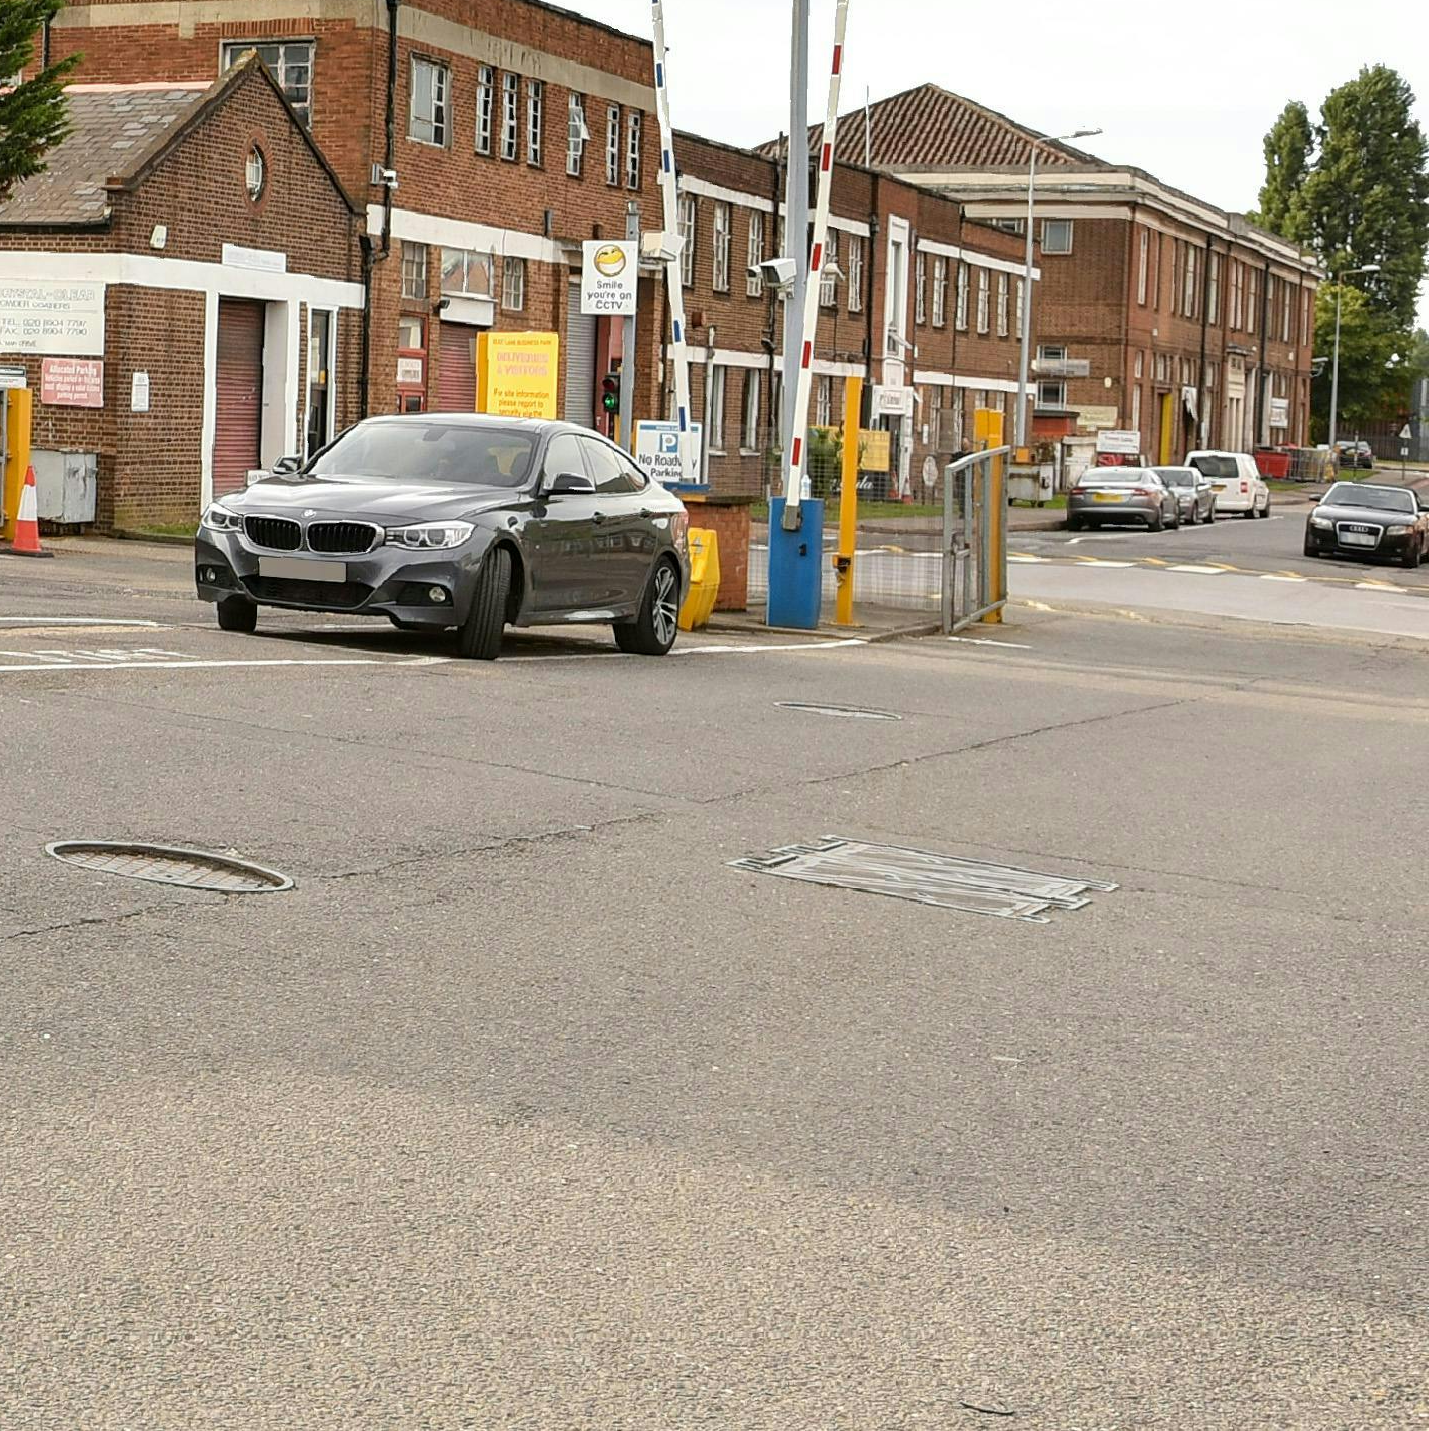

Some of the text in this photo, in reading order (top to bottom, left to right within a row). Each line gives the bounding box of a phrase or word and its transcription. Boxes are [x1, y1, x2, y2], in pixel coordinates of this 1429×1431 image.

[597, 280, 623, 289] Smile
[587, 291, 632, 301] you're on
[595, 300, 623, 309] CCTV
[639, 454, 652, 466] No
